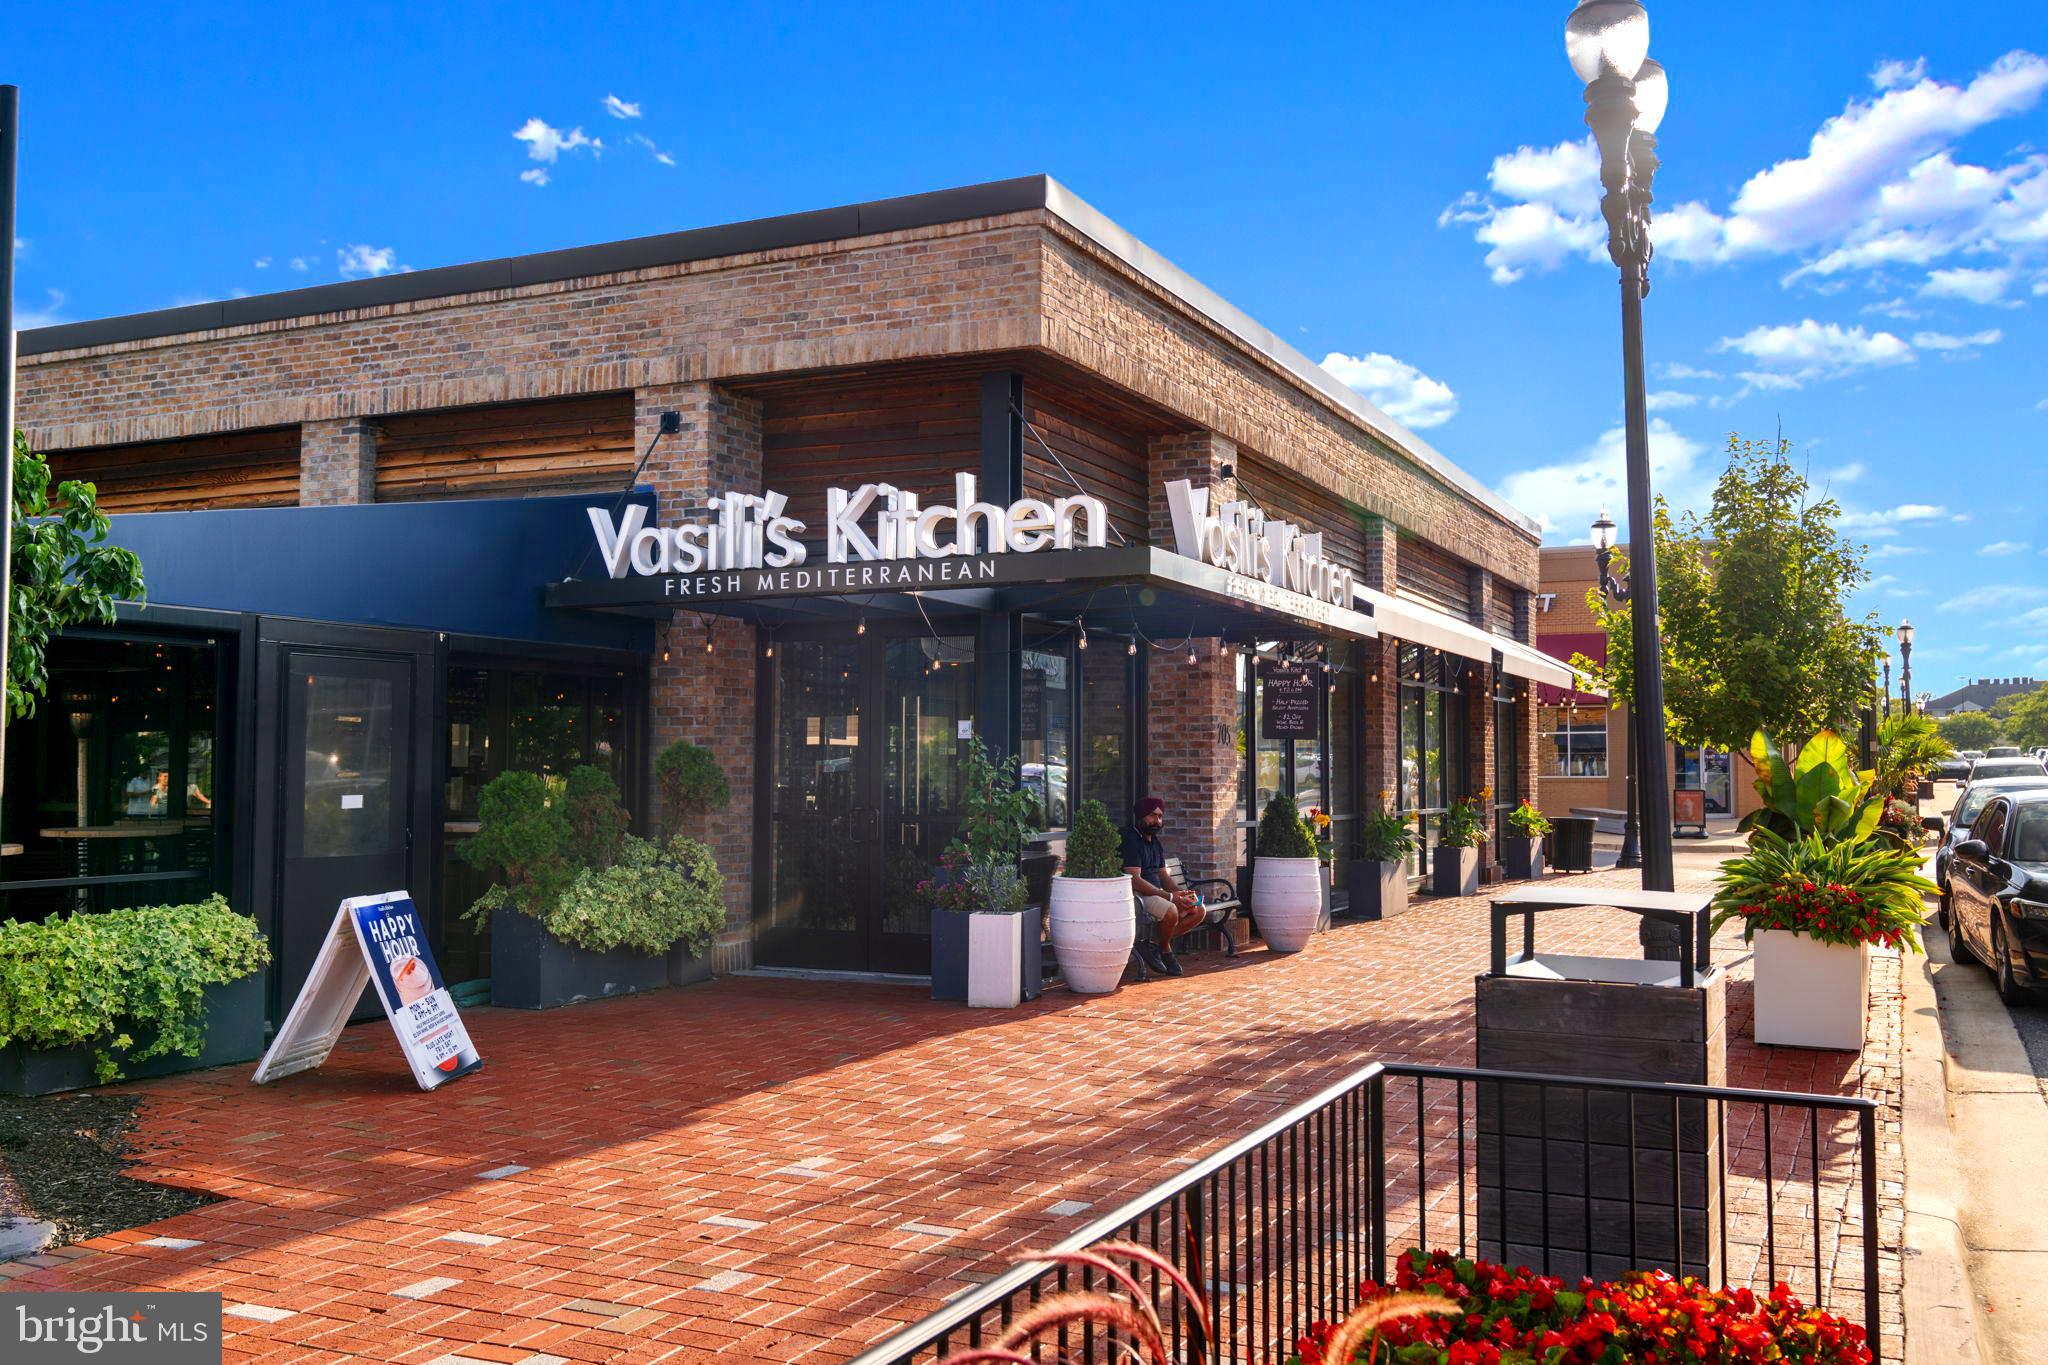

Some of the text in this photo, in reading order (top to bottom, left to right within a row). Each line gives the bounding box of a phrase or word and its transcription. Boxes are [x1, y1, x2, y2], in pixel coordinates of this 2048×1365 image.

[587, 471, 1108, 579] Vasili's Kitchen
[664, 559, 997, 597] FRESH MEDITERRANEAN
[1268, 679, 1314, 688] HAPPY HOUR
[1217, 722, 1231, 746] 705
[368, 913, 416, 943] HAPPY
[379, 935, 421, 964] HOUR
